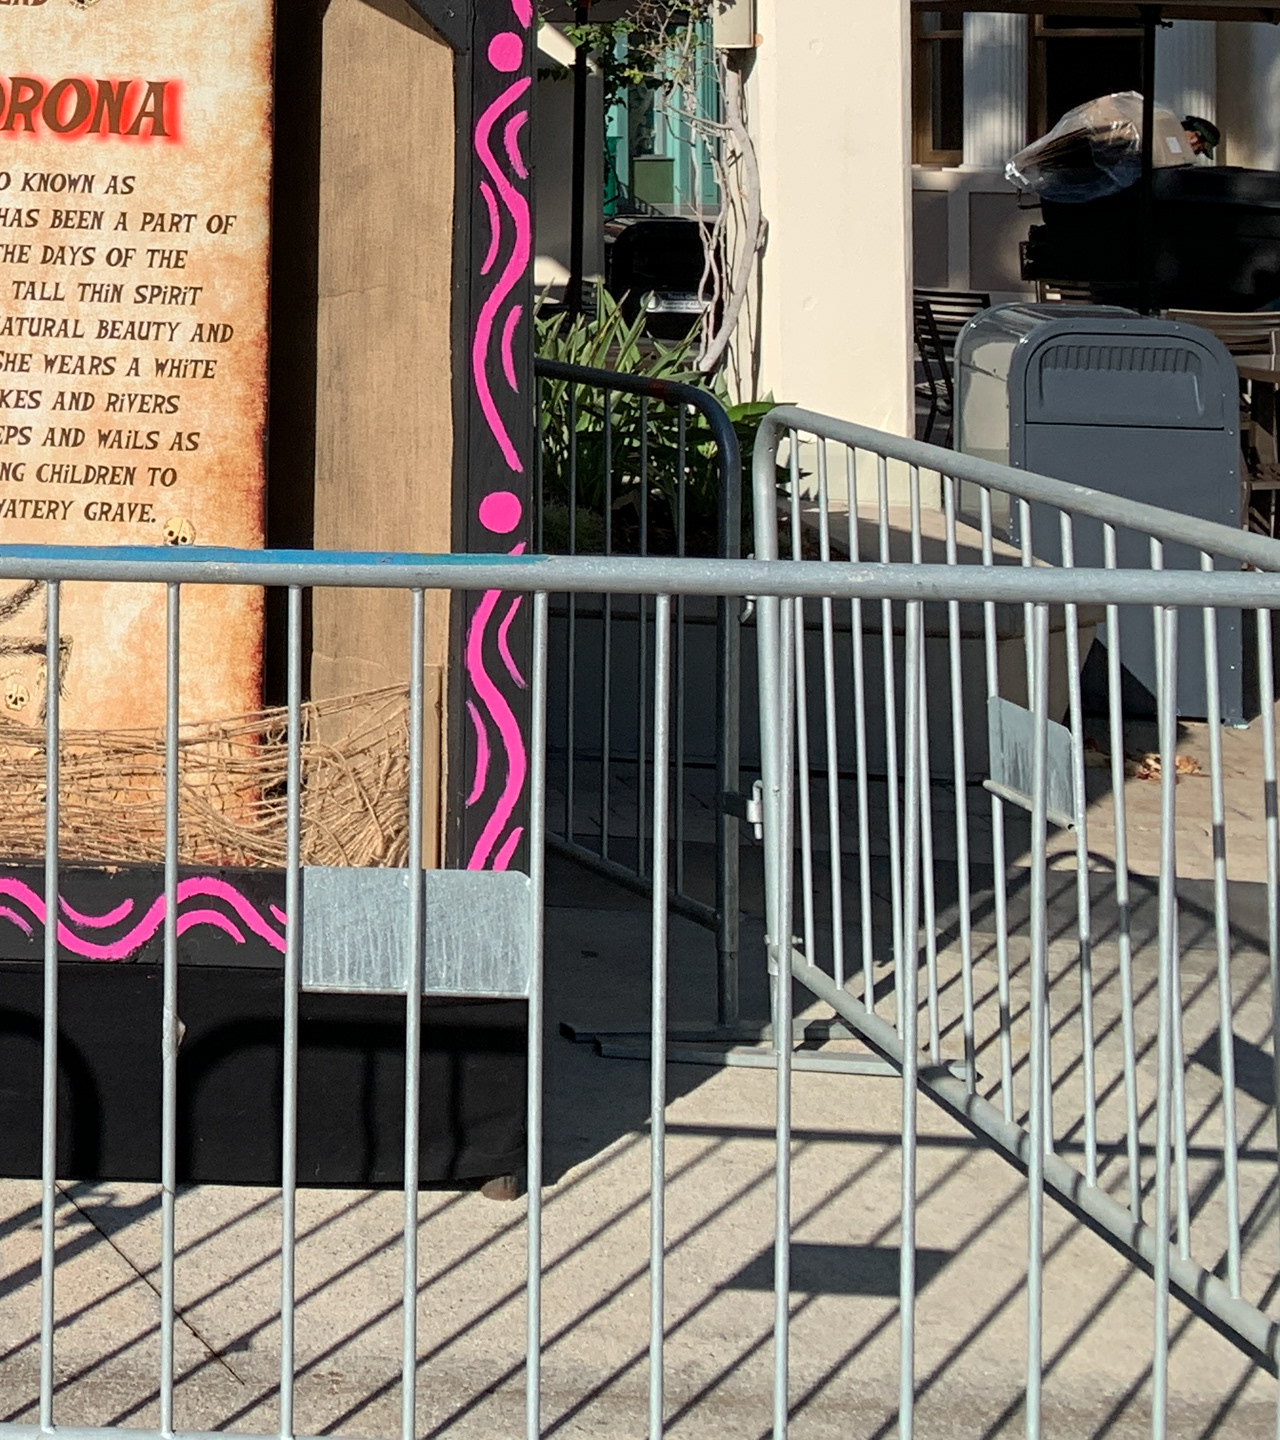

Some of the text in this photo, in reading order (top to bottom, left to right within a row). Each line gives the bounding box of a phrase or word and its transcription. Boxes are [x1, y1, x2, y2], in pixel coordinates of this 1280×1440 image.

[20, 172, 96, 194] KNOWN
[103, 175, 136, 195] AS
[49, 209, 105, 230] BEEN
[113, 211, 128, 232] A
[139, 211, 198, 233] PART
[205, 214, 238, 235] OF
[39, 244, 97, 267] DAYS
[105, 247, 137, 268] OF
[145, 248, 189, 270] THE
[11, 280, 65, 302] TALL
[95, 319, 181, 342] BEAUTY
[189, 323, 234, 344] AND
[43, 354, 117, 376] WEARS
[125, 357, 141, 377] A
[51, 391, 96, 412] AND
[41, 427, 86, 448] AND
[168, 431, 201, 452] AS
[147, 466, 178, 488] TO
[83, 501, 157, 524] GRAVE.
